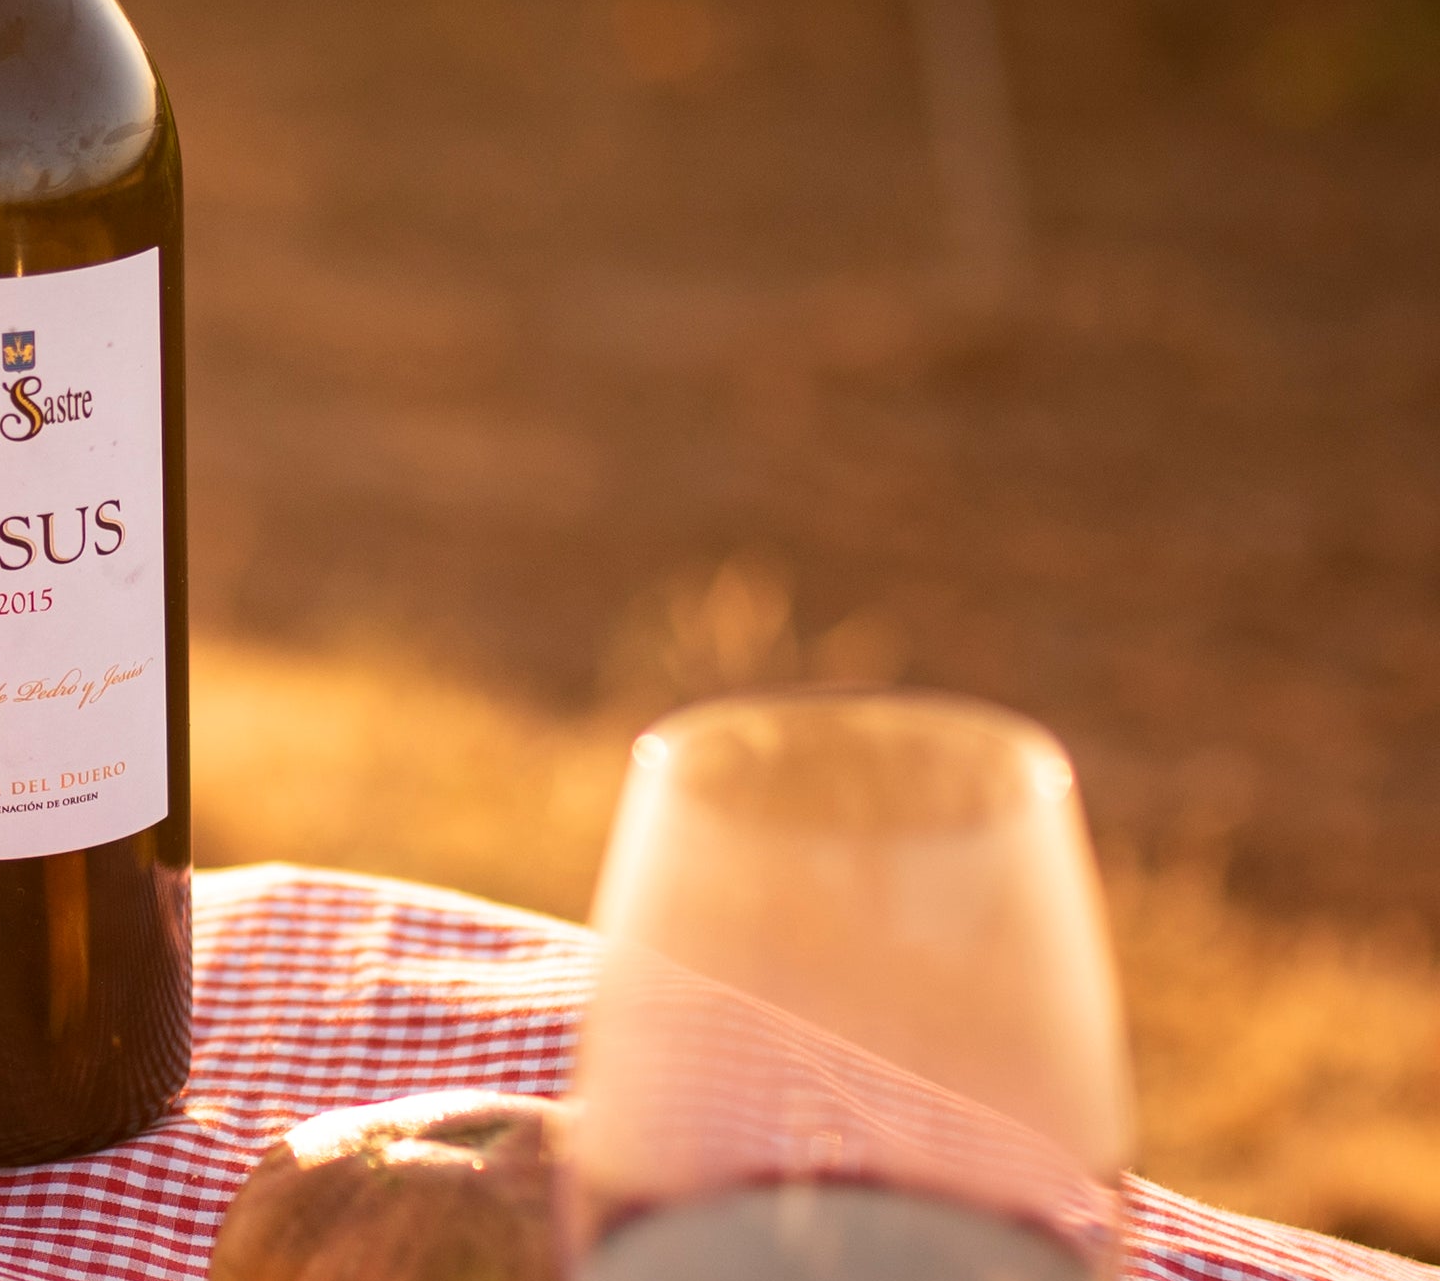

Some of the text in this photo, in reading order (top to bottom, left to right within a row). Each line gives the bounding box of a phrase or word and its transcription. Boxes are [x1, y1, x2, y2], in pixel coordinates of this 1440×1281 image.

[0, 375, 93, 442] Sastre
[13, 668, 82, 703] Pedro
[77, 680, 96, 710] y
[89, 657, 154, 704] Jesús
[11, 778, 51, 796] DEL
[60, 761, 127, 790] DUERO
[46, 799, 61, 810] DE
[62, 791, 99, 807] ORIGEN
